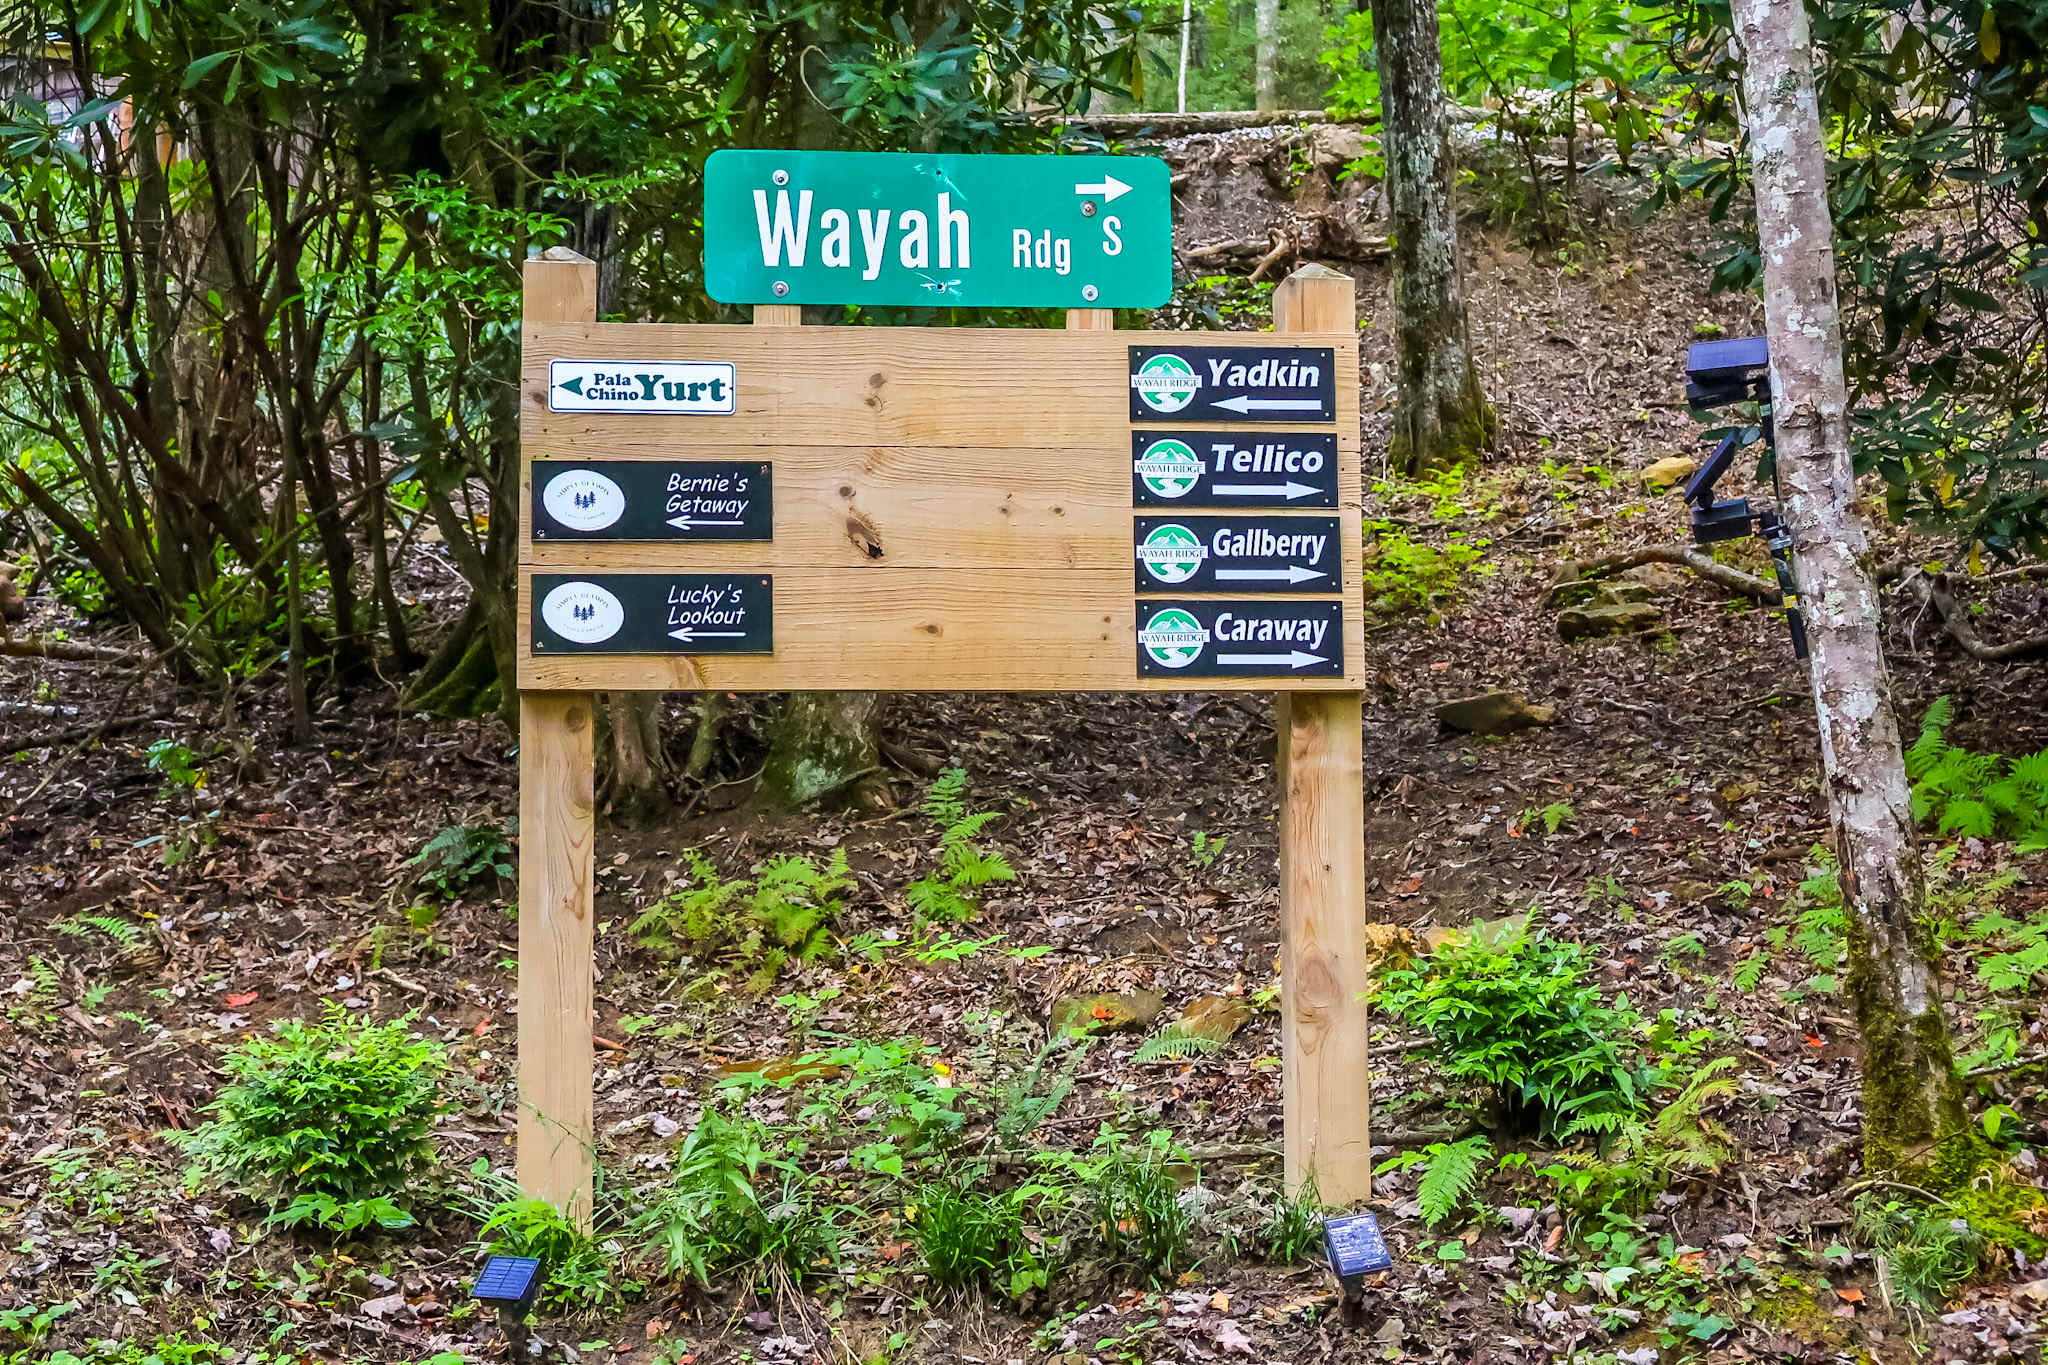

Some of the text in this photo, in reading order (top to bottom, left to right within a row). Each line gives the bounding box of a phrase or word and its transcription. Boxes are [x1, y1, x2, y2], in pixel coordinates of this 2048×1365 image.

[752, 189, 1123, 281] Wayah Rdg S
[594, 372, 631, 387] Pala
[1133, 379, 1198, 387] WAYAH RIDGE
[1207, 358, 1320, 388] Yadkin
[586, 387, 639, 401] Chino
[635, 374, 726, 402] Yurt
[1137, 465, 1201, 473] WAYAH RIDGE
[1211, 444, 1324, 474] Tellico
[666, 473, 749, 492] Bernie's
[666, 494, 749, 519] Getaway
[1139, 550, 1204, 558] WAYAH RIDGE
[1212, 528, 1327, 565] Gallberry
[667, 583, 742, 609] Lucky's
[667, 606, 746, 625] Lookout
[1140, 634, 1205, 642] WAYAH RIDGE
[1214, 612, 1329, 649] Caraway
